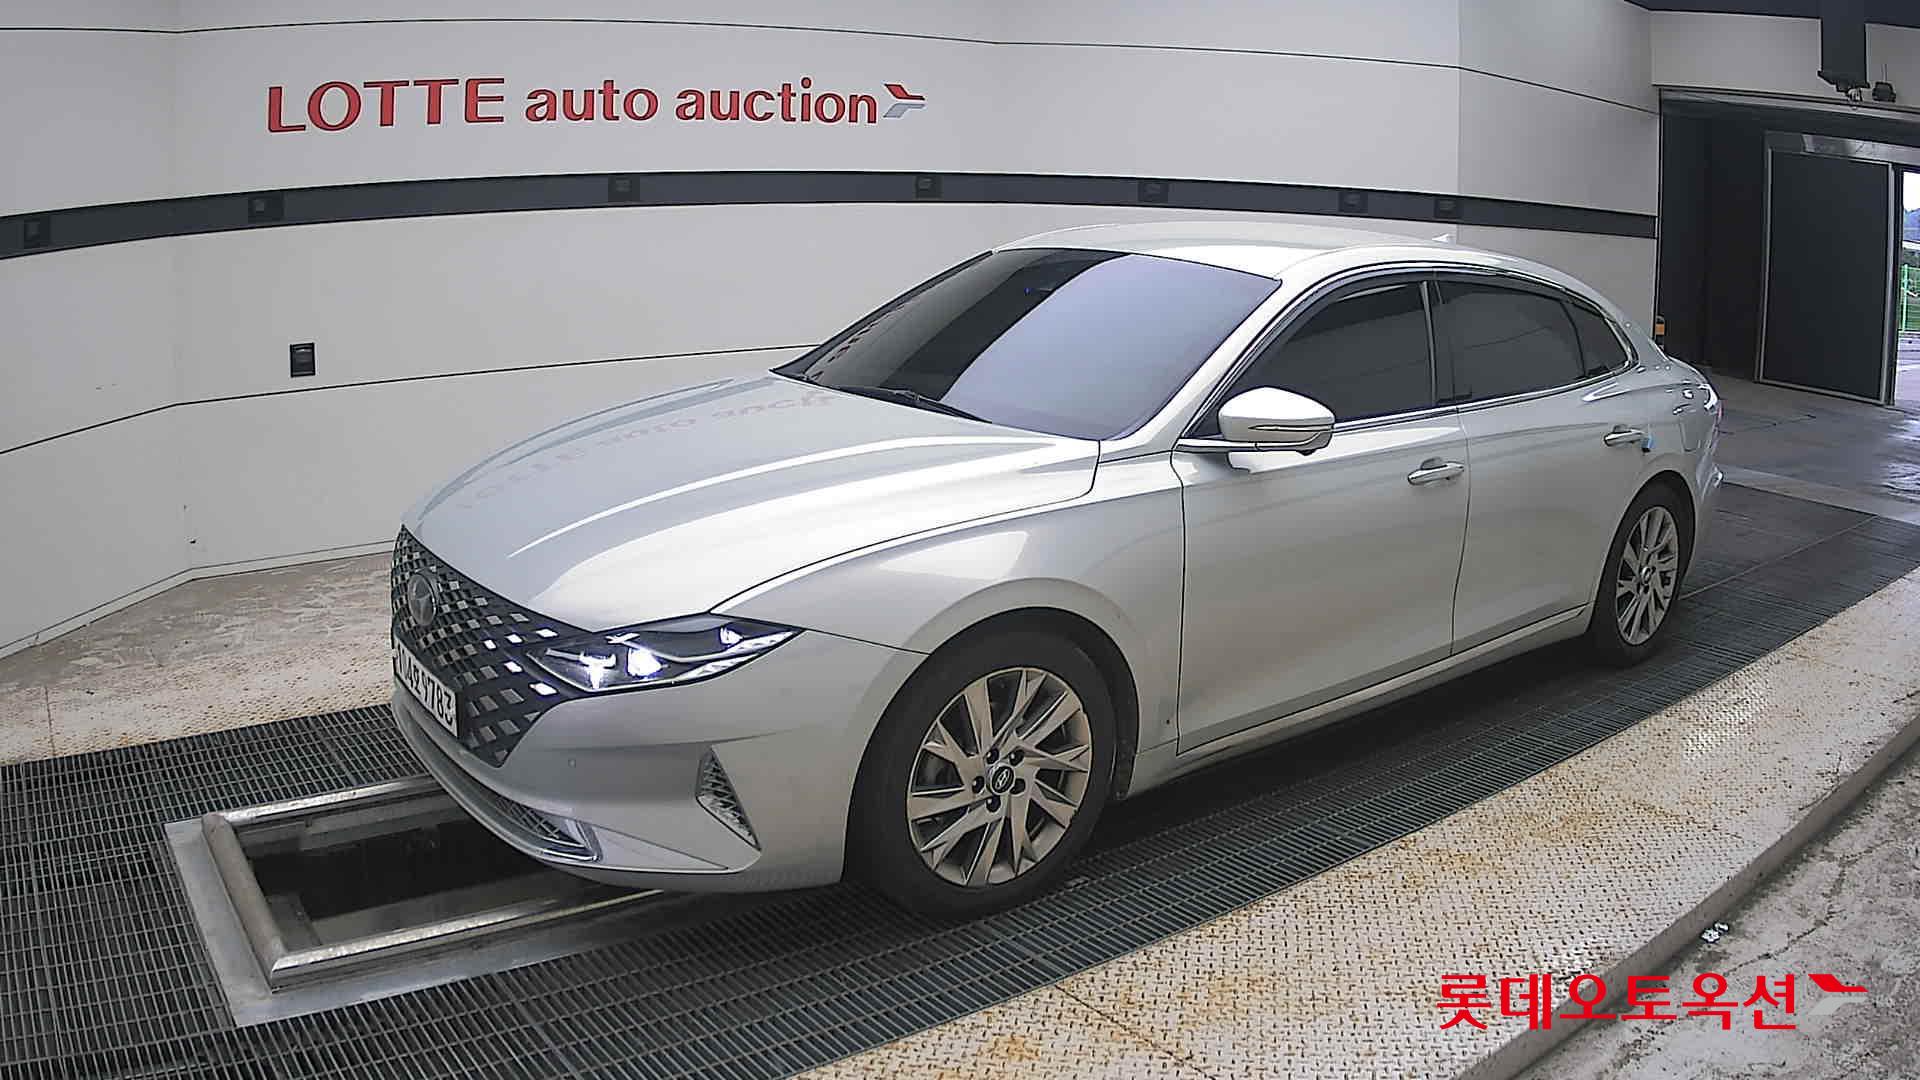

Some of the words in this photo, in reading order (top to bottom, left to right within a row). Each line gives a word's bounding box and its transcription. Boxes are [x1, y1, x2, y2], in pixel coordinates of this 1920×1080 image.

[268, 77, 505, 133] LOTTE
[526, 80, 658, 122] auto
[675, 77, 878, 124] auction
